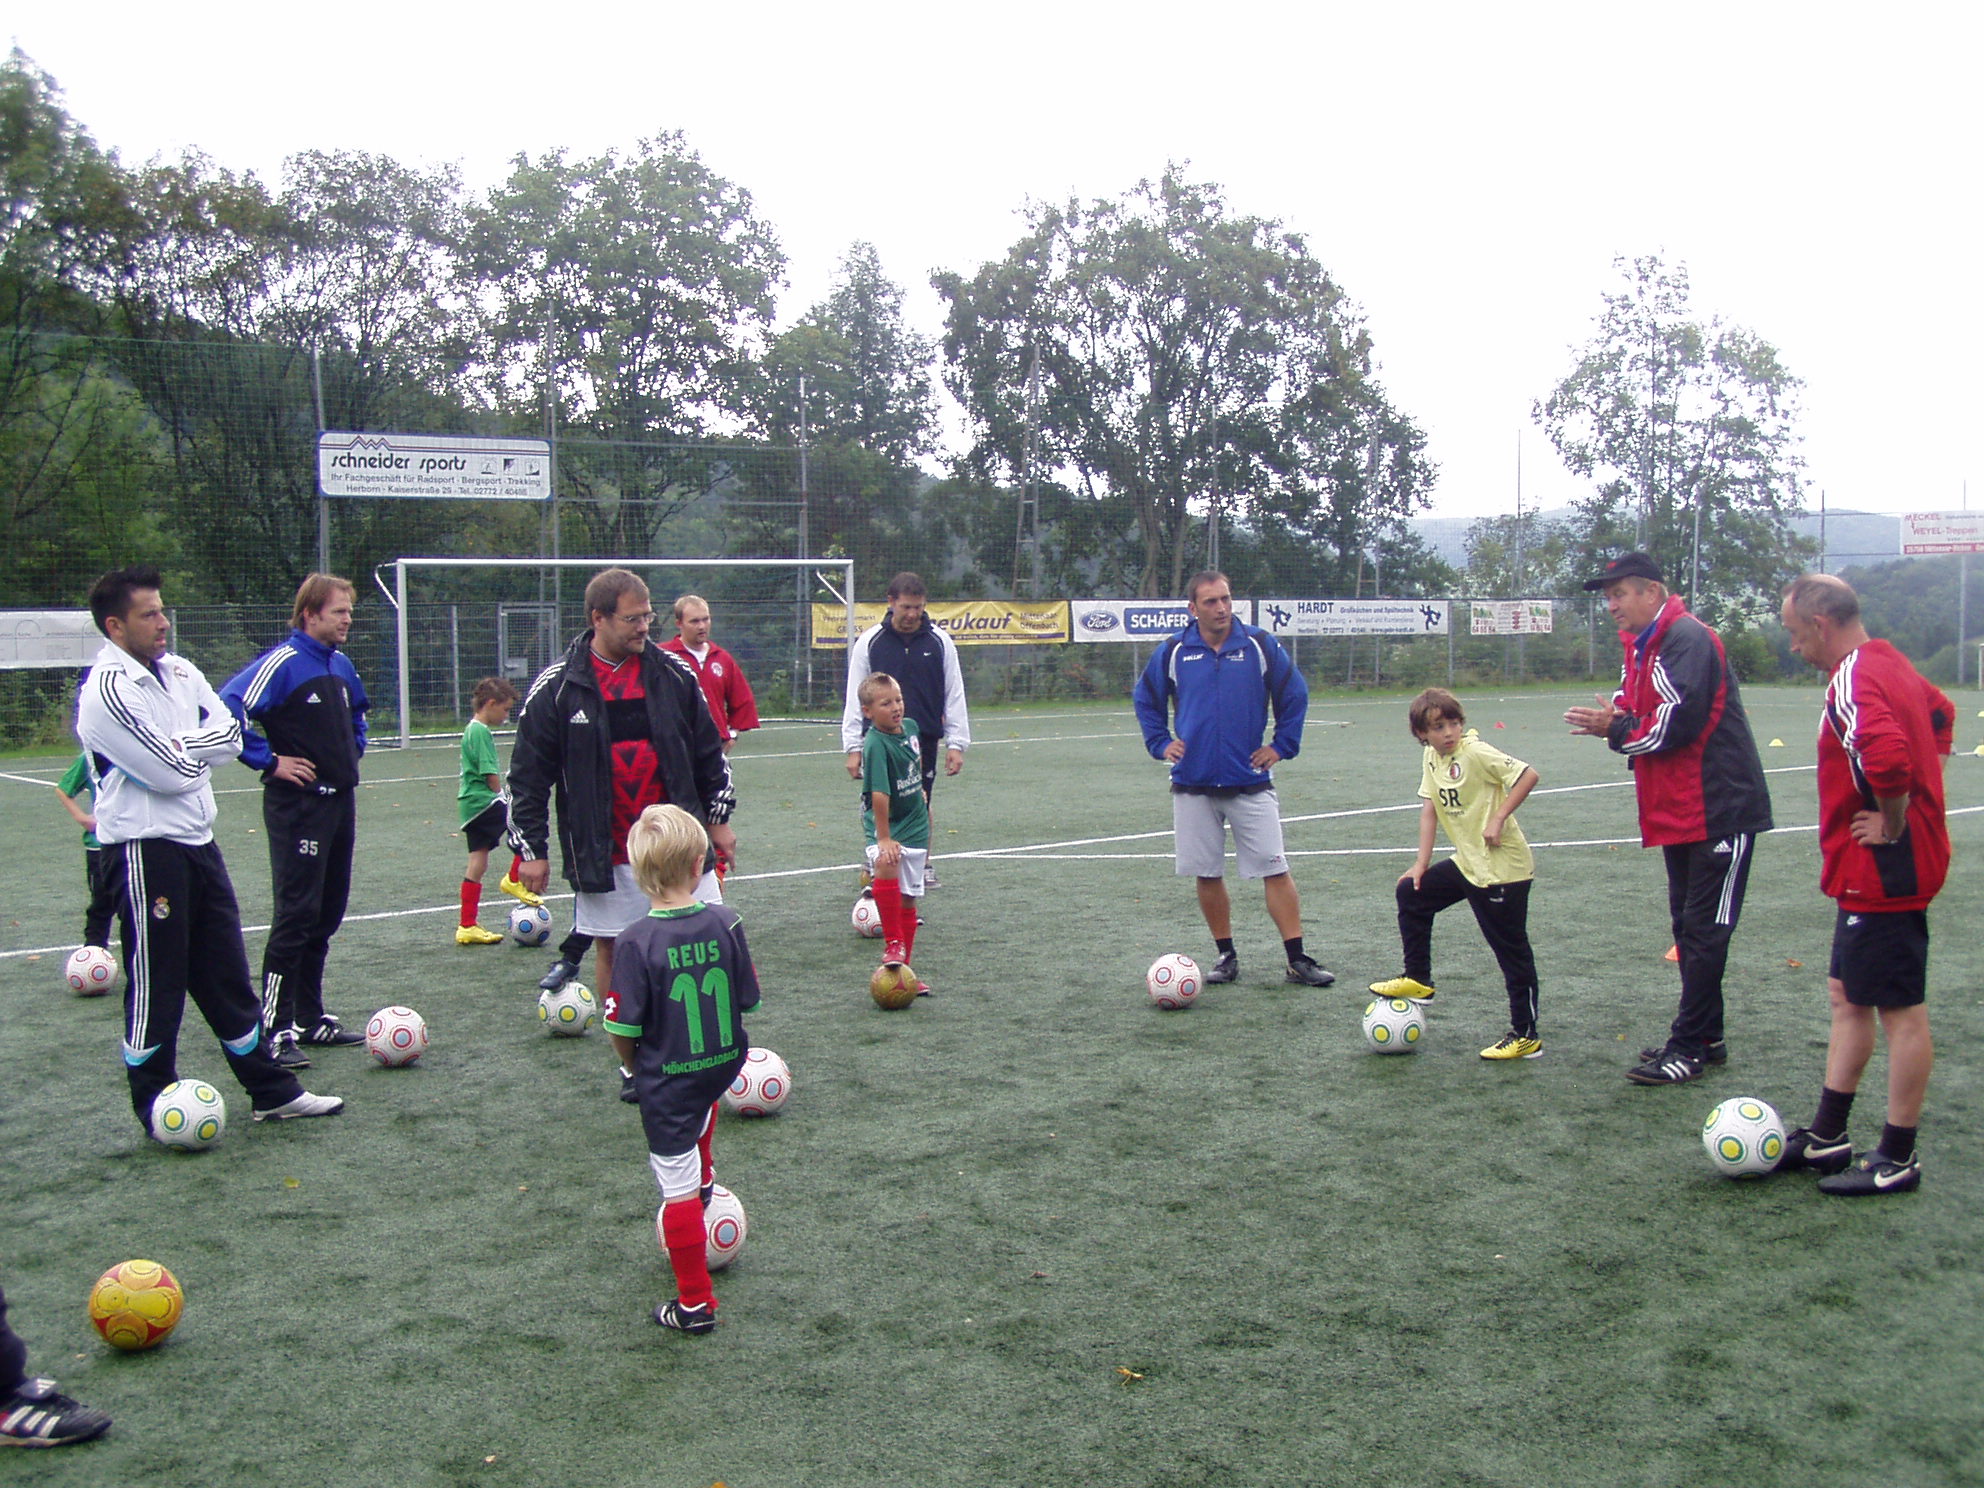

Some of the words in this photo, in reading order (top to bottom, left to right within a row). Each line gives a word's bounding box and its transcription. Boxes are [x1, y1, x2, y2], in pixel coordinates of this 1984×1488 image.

[331, 452, 410, 469] schneider
[419, 456, 467, 473] sports
[331, 473, 342, 481] Ihr
[345, 473, 401, 484] Fachgeschäft
[403, 474, 415, 482] für
[417, 475, 455, 486] Radsport
[462, 476, 502, 487] Bergsport
[508, 477, 541, 488] Trekking
[346, 485, 381, 493] Herborn
[388, 486, 440, 494] Kaiserstraße
[1297, 602, 1335, 613] HARDT
[1087, 612, 1113, 628] Ford
[1131, 611, 1190, 629] SCHÄFER
[1438, 787, 1462, 808] SR
[298, 838, 319, 856] 35
[666, 939, 721, 970] REUS
[668, 966, 734, 1055] 11
